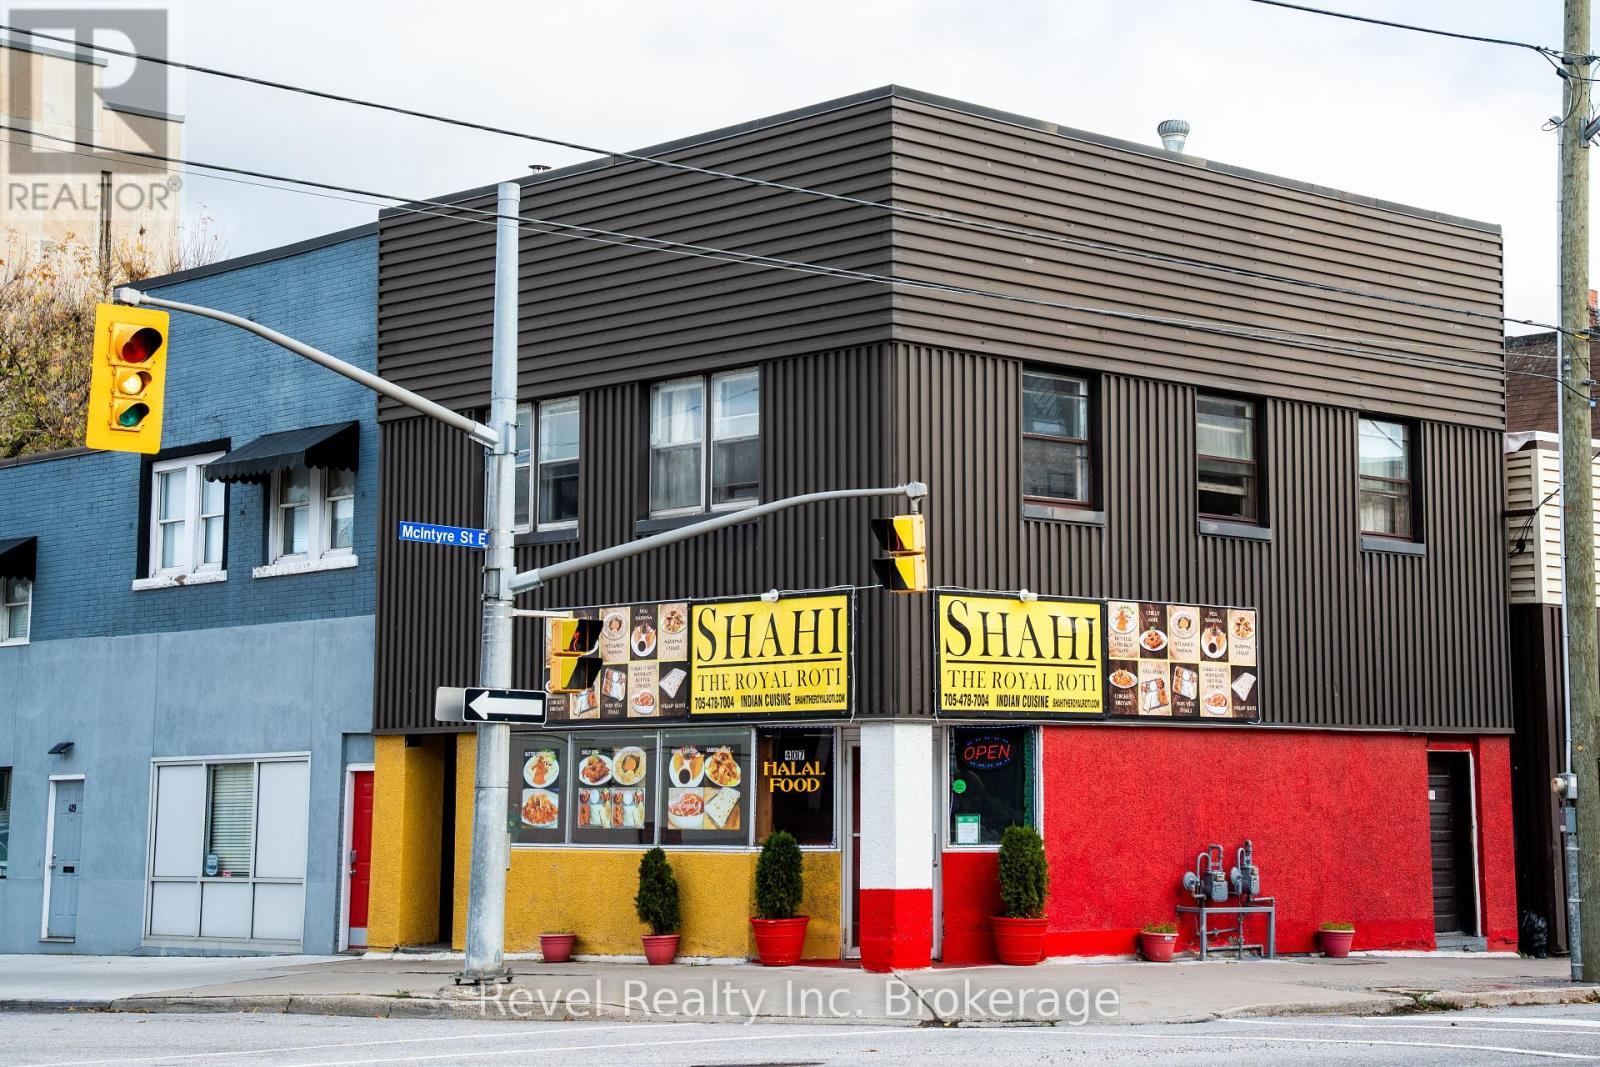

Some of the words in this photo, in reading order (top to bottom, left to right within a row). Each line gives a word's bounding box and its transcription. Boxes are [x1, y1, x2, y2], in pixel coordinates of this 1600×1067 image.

[402, 525, 455, 543] McIntyre
[460, 531, 474, 544] St
[478, 533, 486, 545] E
[696, 607, 843, 662] SHAHI
[945, 600, 1097, 661] SHAHI
[697, 673, 731, 691] THE
[736, 670, 793, 690] ROYAL
[797, 668, 841, 687] ROTI
[947, 670, 986, 689] THE
[992, 671, 1051, 691] ROYAL
[1056, 673, 1096, 691] ROTI
[695, 697, 735, 709] 705-478-7004
[740, 694, 763, 708] INDIAN
[764, 693, 792, 707] CUISINE
[944, 694, 989, 707] 705-478-7004
[996, 694, 1021, 708] INDIAN
[1022, 694, 1049, 708] CUISINE
[784, 750, 805, 760] 407
[964, 744, 1011, 760] OPEN
[763, 761, 826, 776] HALAL
[769, 778, 820, 793] FOOD
